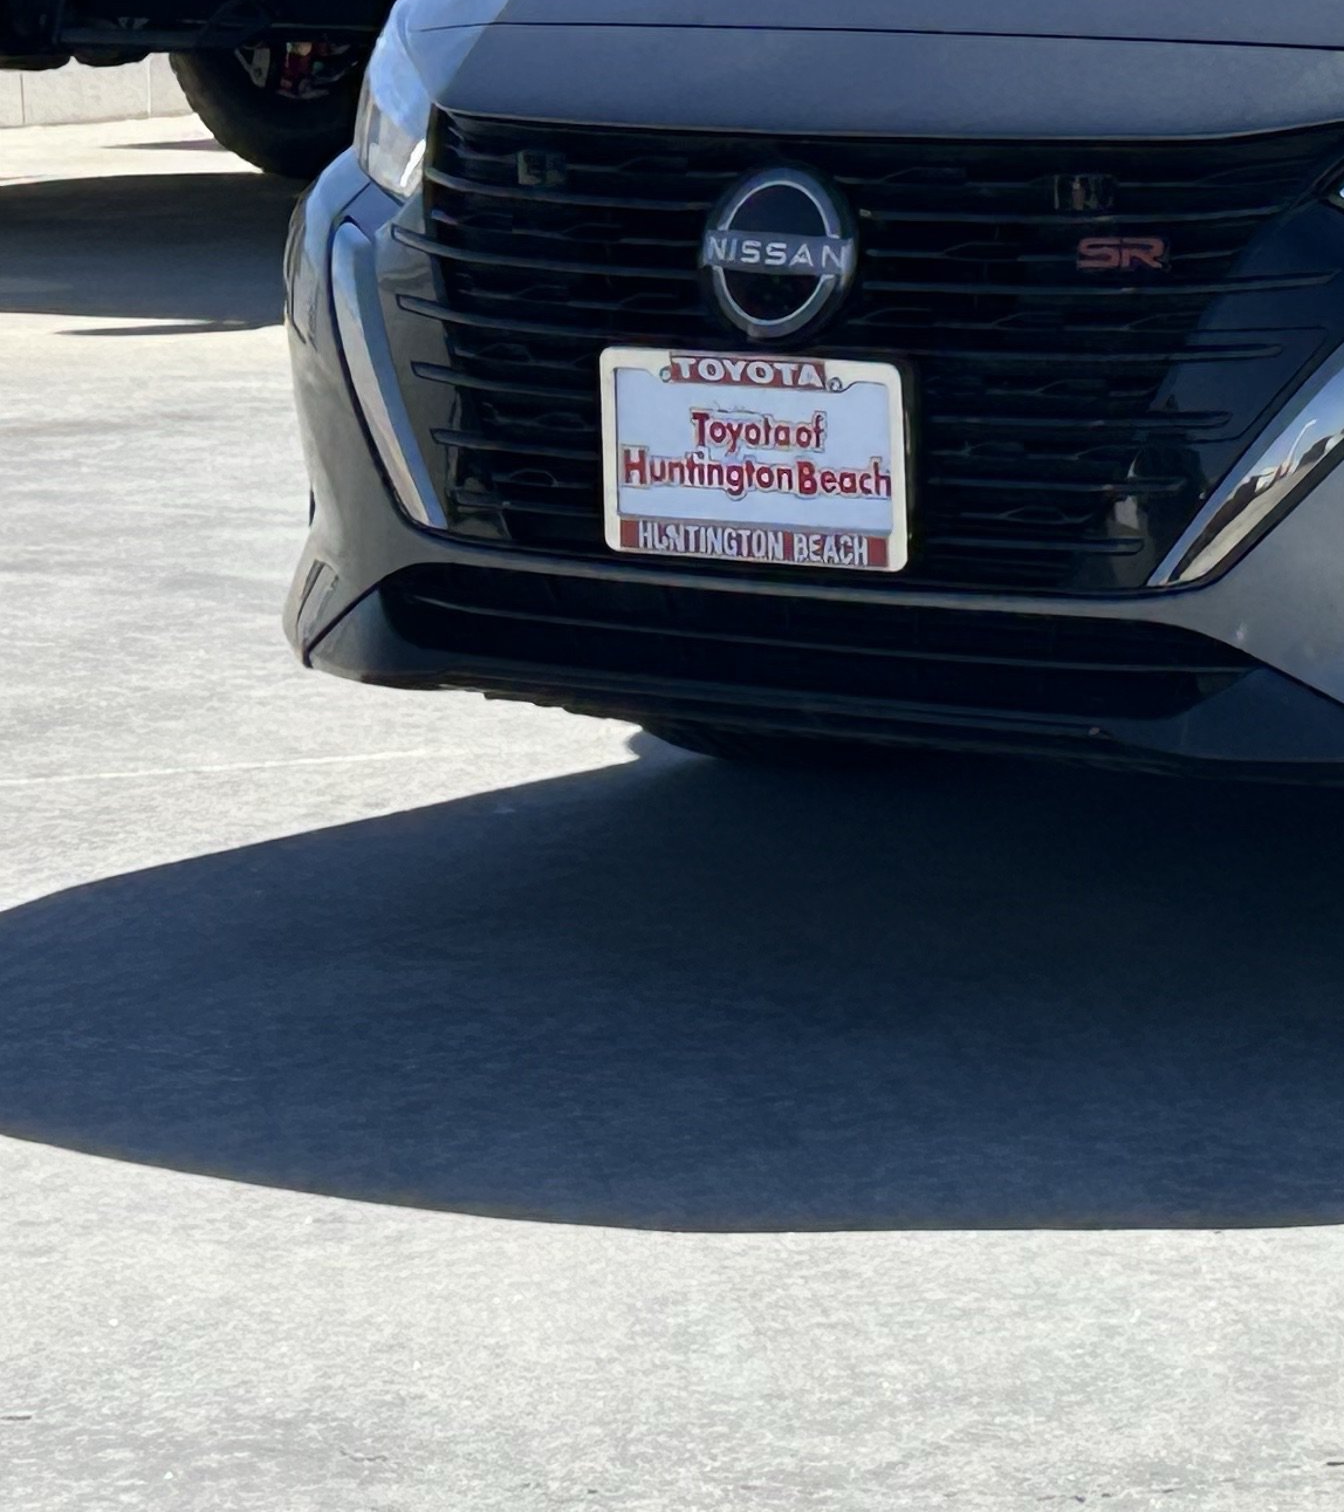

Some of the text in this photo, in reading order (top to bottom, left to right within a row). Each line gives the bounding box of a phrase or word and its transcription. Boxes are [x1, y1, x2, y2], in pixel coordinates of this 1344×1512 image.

[707, 236, 846, 269] NISSAN
[1077, 238, 1164, 269] SR
[673, 358, 824, 387] TOYOTA
[692, 411, 826, 453] Toyota of
[623, 449, 892, 497] Huntington Beach
[638, 520, 869, 567] HUNTINGTON BEACH
